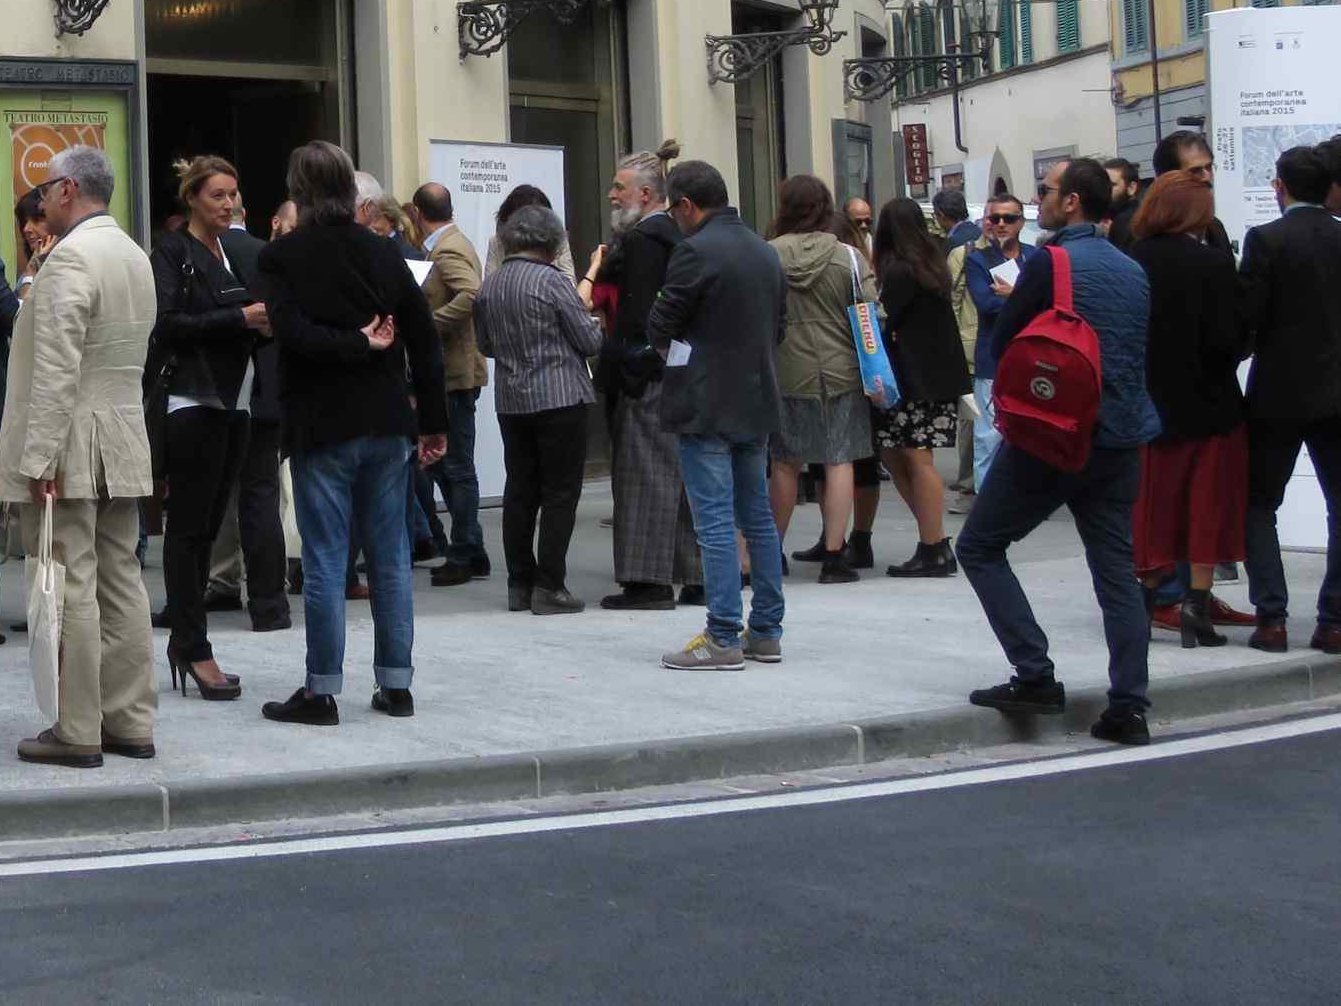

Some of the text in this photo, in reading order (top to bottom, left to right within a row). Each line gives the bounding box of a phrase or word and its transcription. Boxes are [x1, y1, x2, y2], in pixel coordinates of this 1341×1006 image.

[1272, 106, 1295, 115] 2015
[4, 112, 108, 123] TEATRO METASTASIO
[460, 158, 479, 169] Forum
[460, 183, 501, 194] italiana 2015
